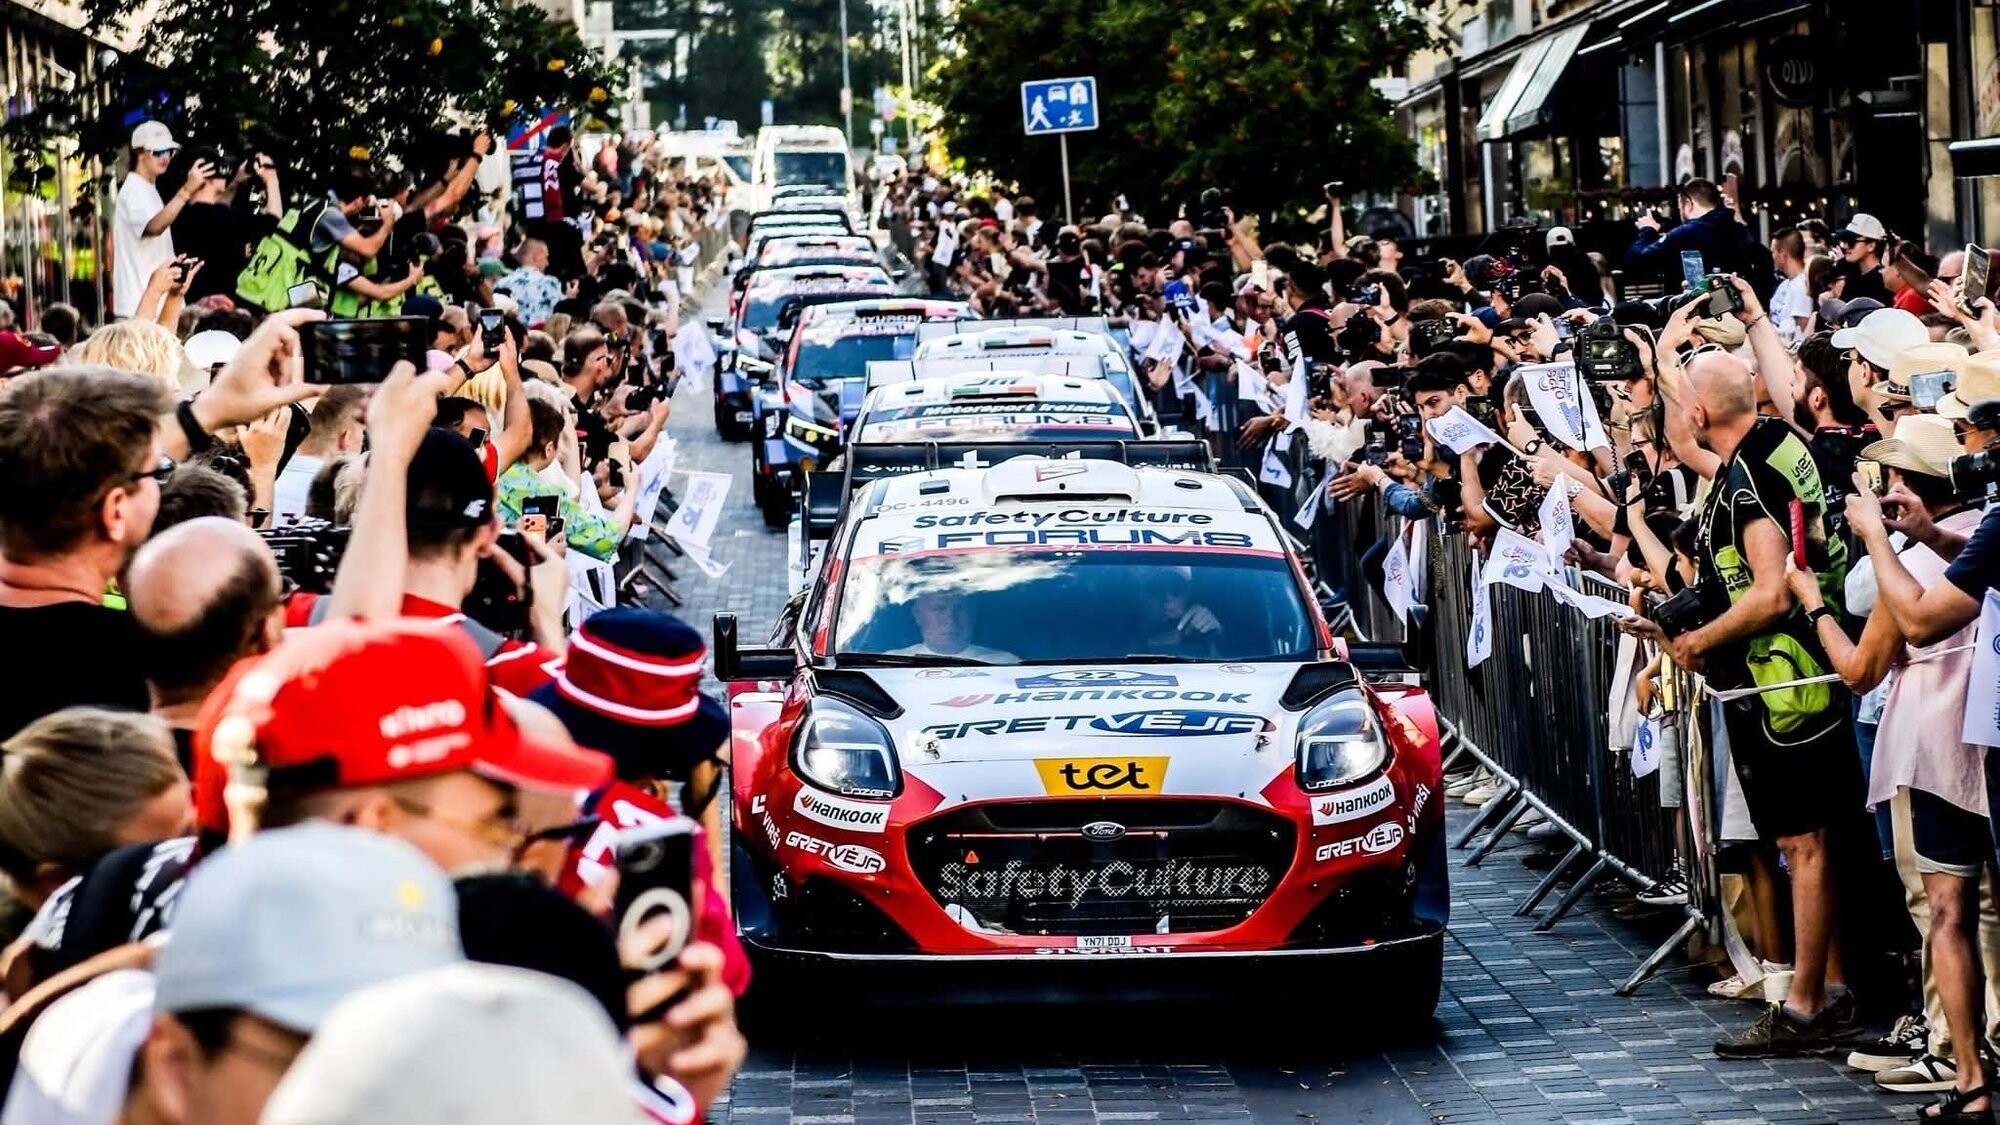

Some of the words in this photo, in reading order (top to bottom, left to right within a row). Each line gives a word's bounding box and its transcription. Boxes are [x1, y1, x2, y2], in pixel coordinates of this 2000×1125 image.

[923, 403, 1036, 416] Motorsport
[1038, 403, 1110, 413] Ireland
[876, 497, 970, 512] OC-4496
[913, 510, 1213, 529] SafetyCulture
[937, 530, 1254, 549] FORUM8
[1073, 671, 1117, 680] 22
[1059, 762, 1150, 791] tet
[1412, 783, 1432, 819] VIRŠI
[762, 811, 781, 850] VIRŠI
[1091, 823, 1119, 837] Ford
[938, 860, 1272, 910] SafetyCulture
[1083, 937, 1105, 947] YN71
[1107, 937, 1127, 947] DDJ
